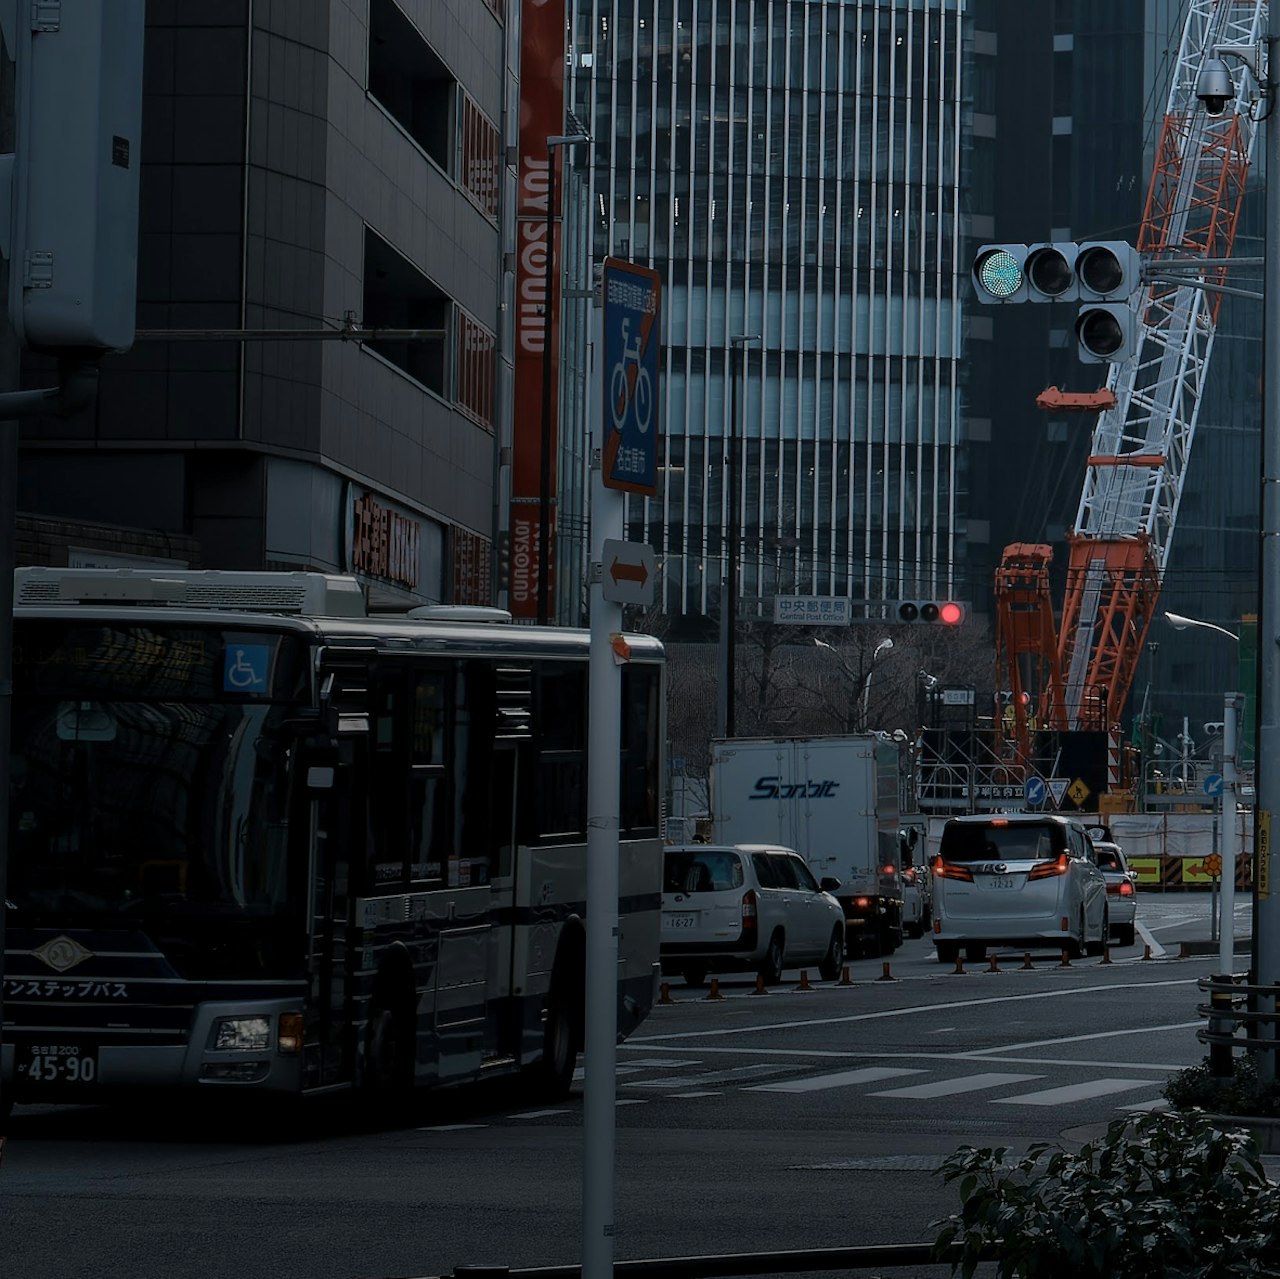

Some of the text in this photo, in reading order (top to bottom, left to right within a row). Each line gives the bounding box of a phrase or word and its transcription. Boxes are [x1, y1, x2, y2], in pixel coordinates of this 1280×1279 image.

[512, 519, 531, 602] JOYSOUND
[780, 600, 845, 613] 中央郵便局
[806, 613, 822, 621] Post
[822, 613, 845, 622] Office
[58, 1046, 79, 1056] 200
[28, 1055, 95, 1082] 45-90
